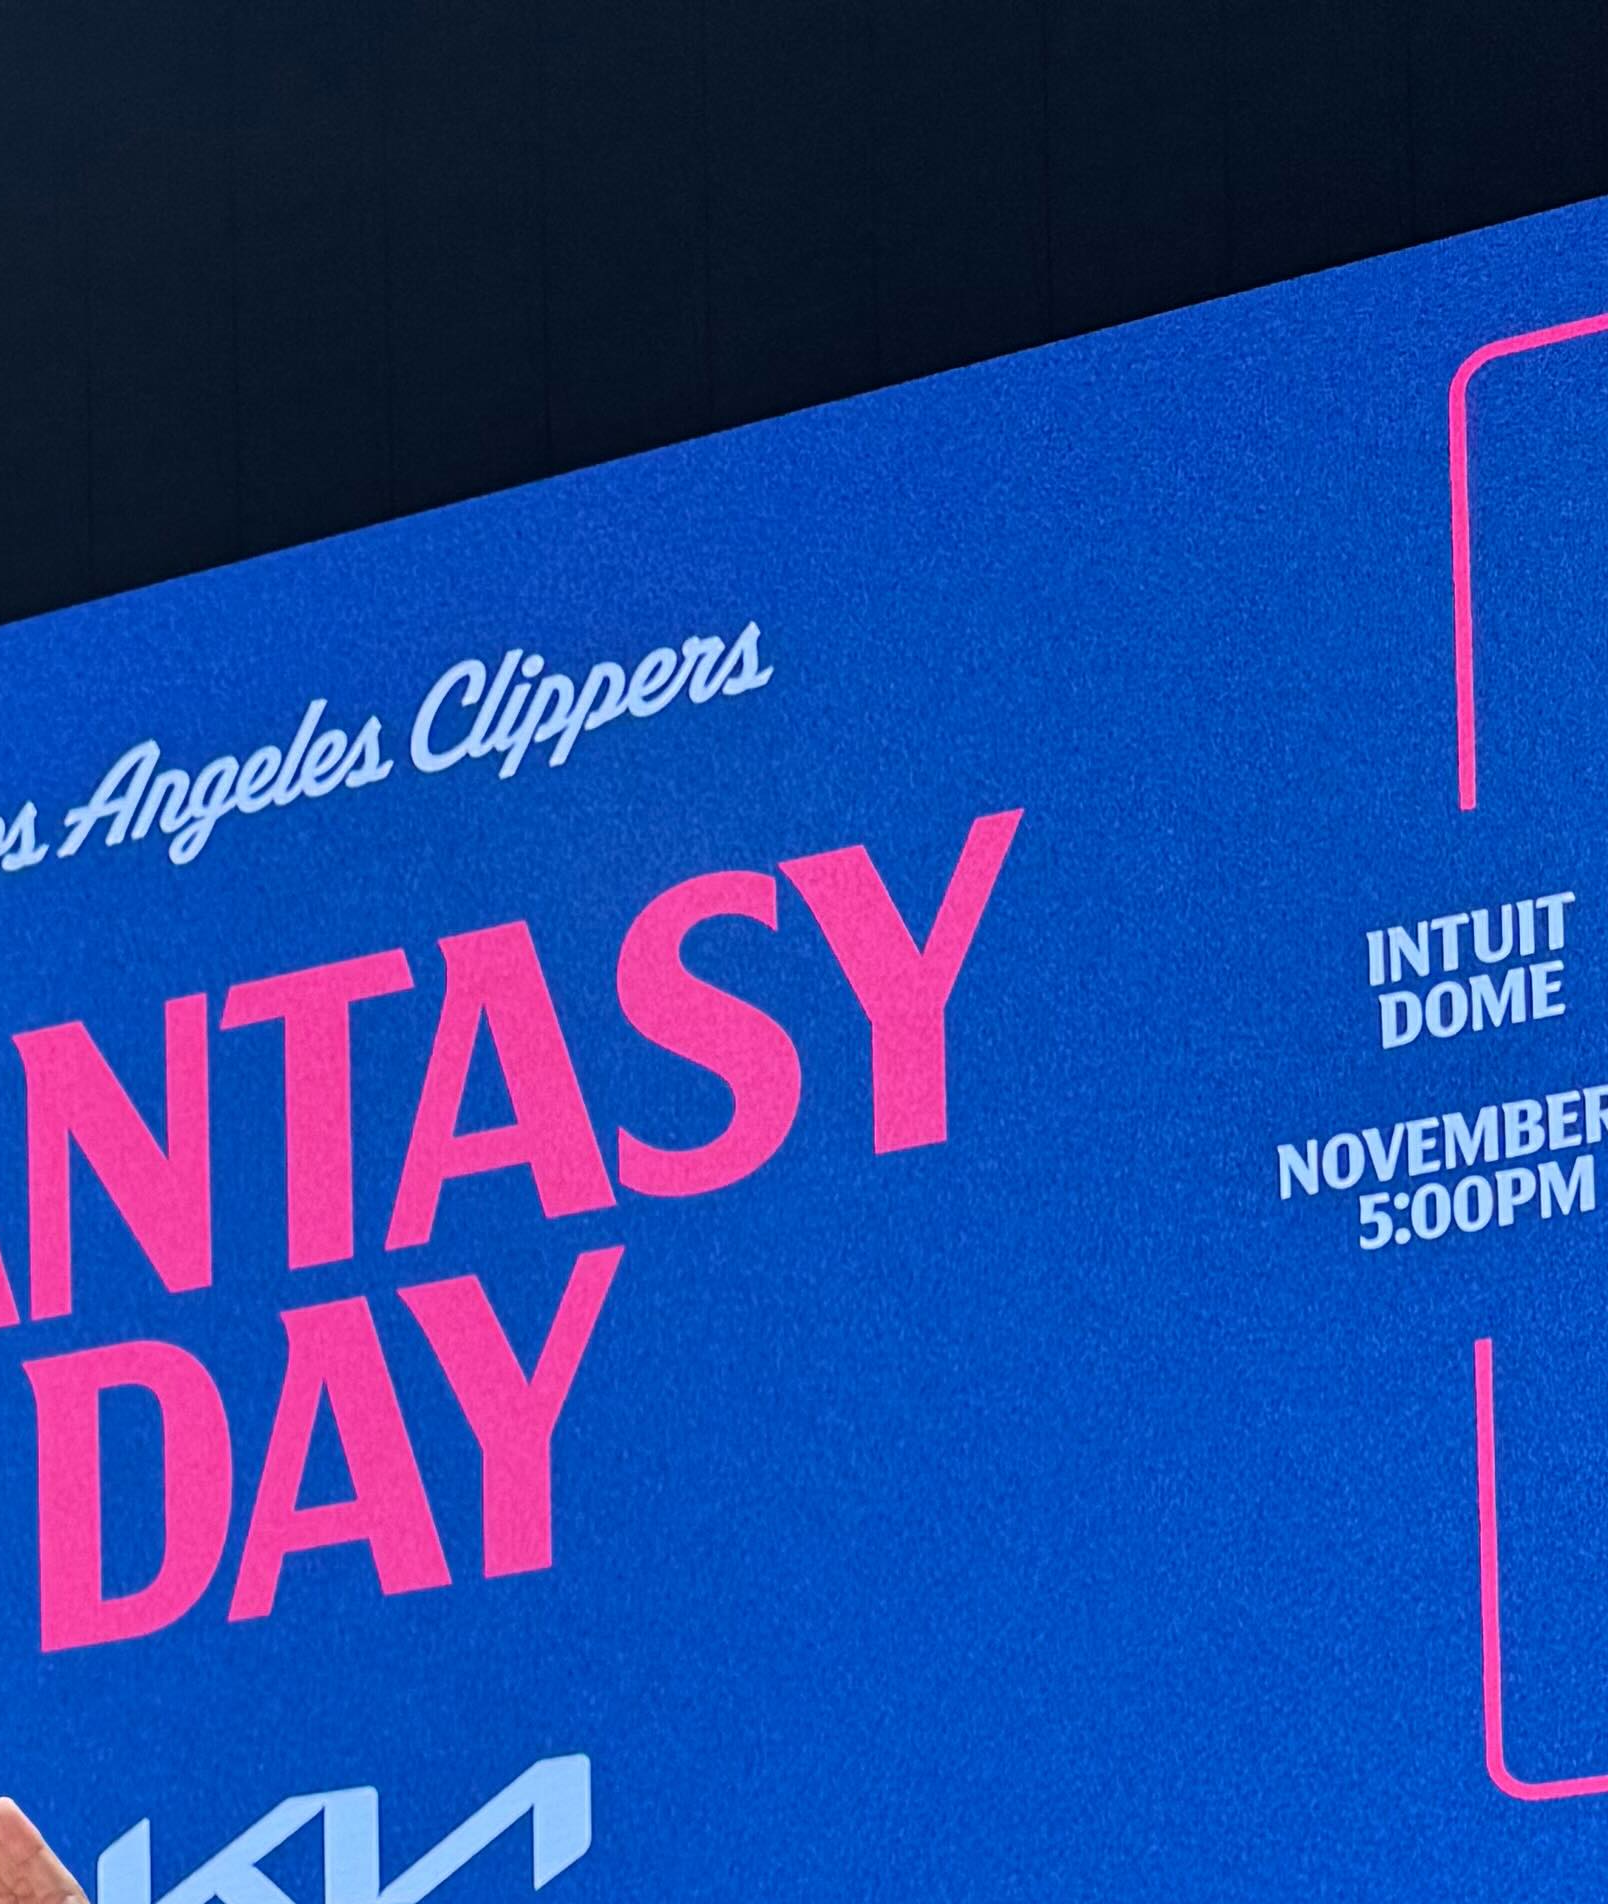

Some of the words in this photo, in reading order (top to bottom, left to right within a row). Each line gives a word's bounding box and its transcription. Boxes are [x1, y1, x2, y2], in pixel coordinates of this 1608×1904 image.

[57, 699, 395, 865] Angeles
[410, 621, 774, 779] Clippers
[1366, 891, 1576, 986] INTUIT
[1378, 960, 1567, 1049] DOME
[1277, 1084, 1608, 1200] NOVEMBER
[1359, 1154, 1596, 1250] 5:00PM
[22, 1246, 625, 1653] DAY
